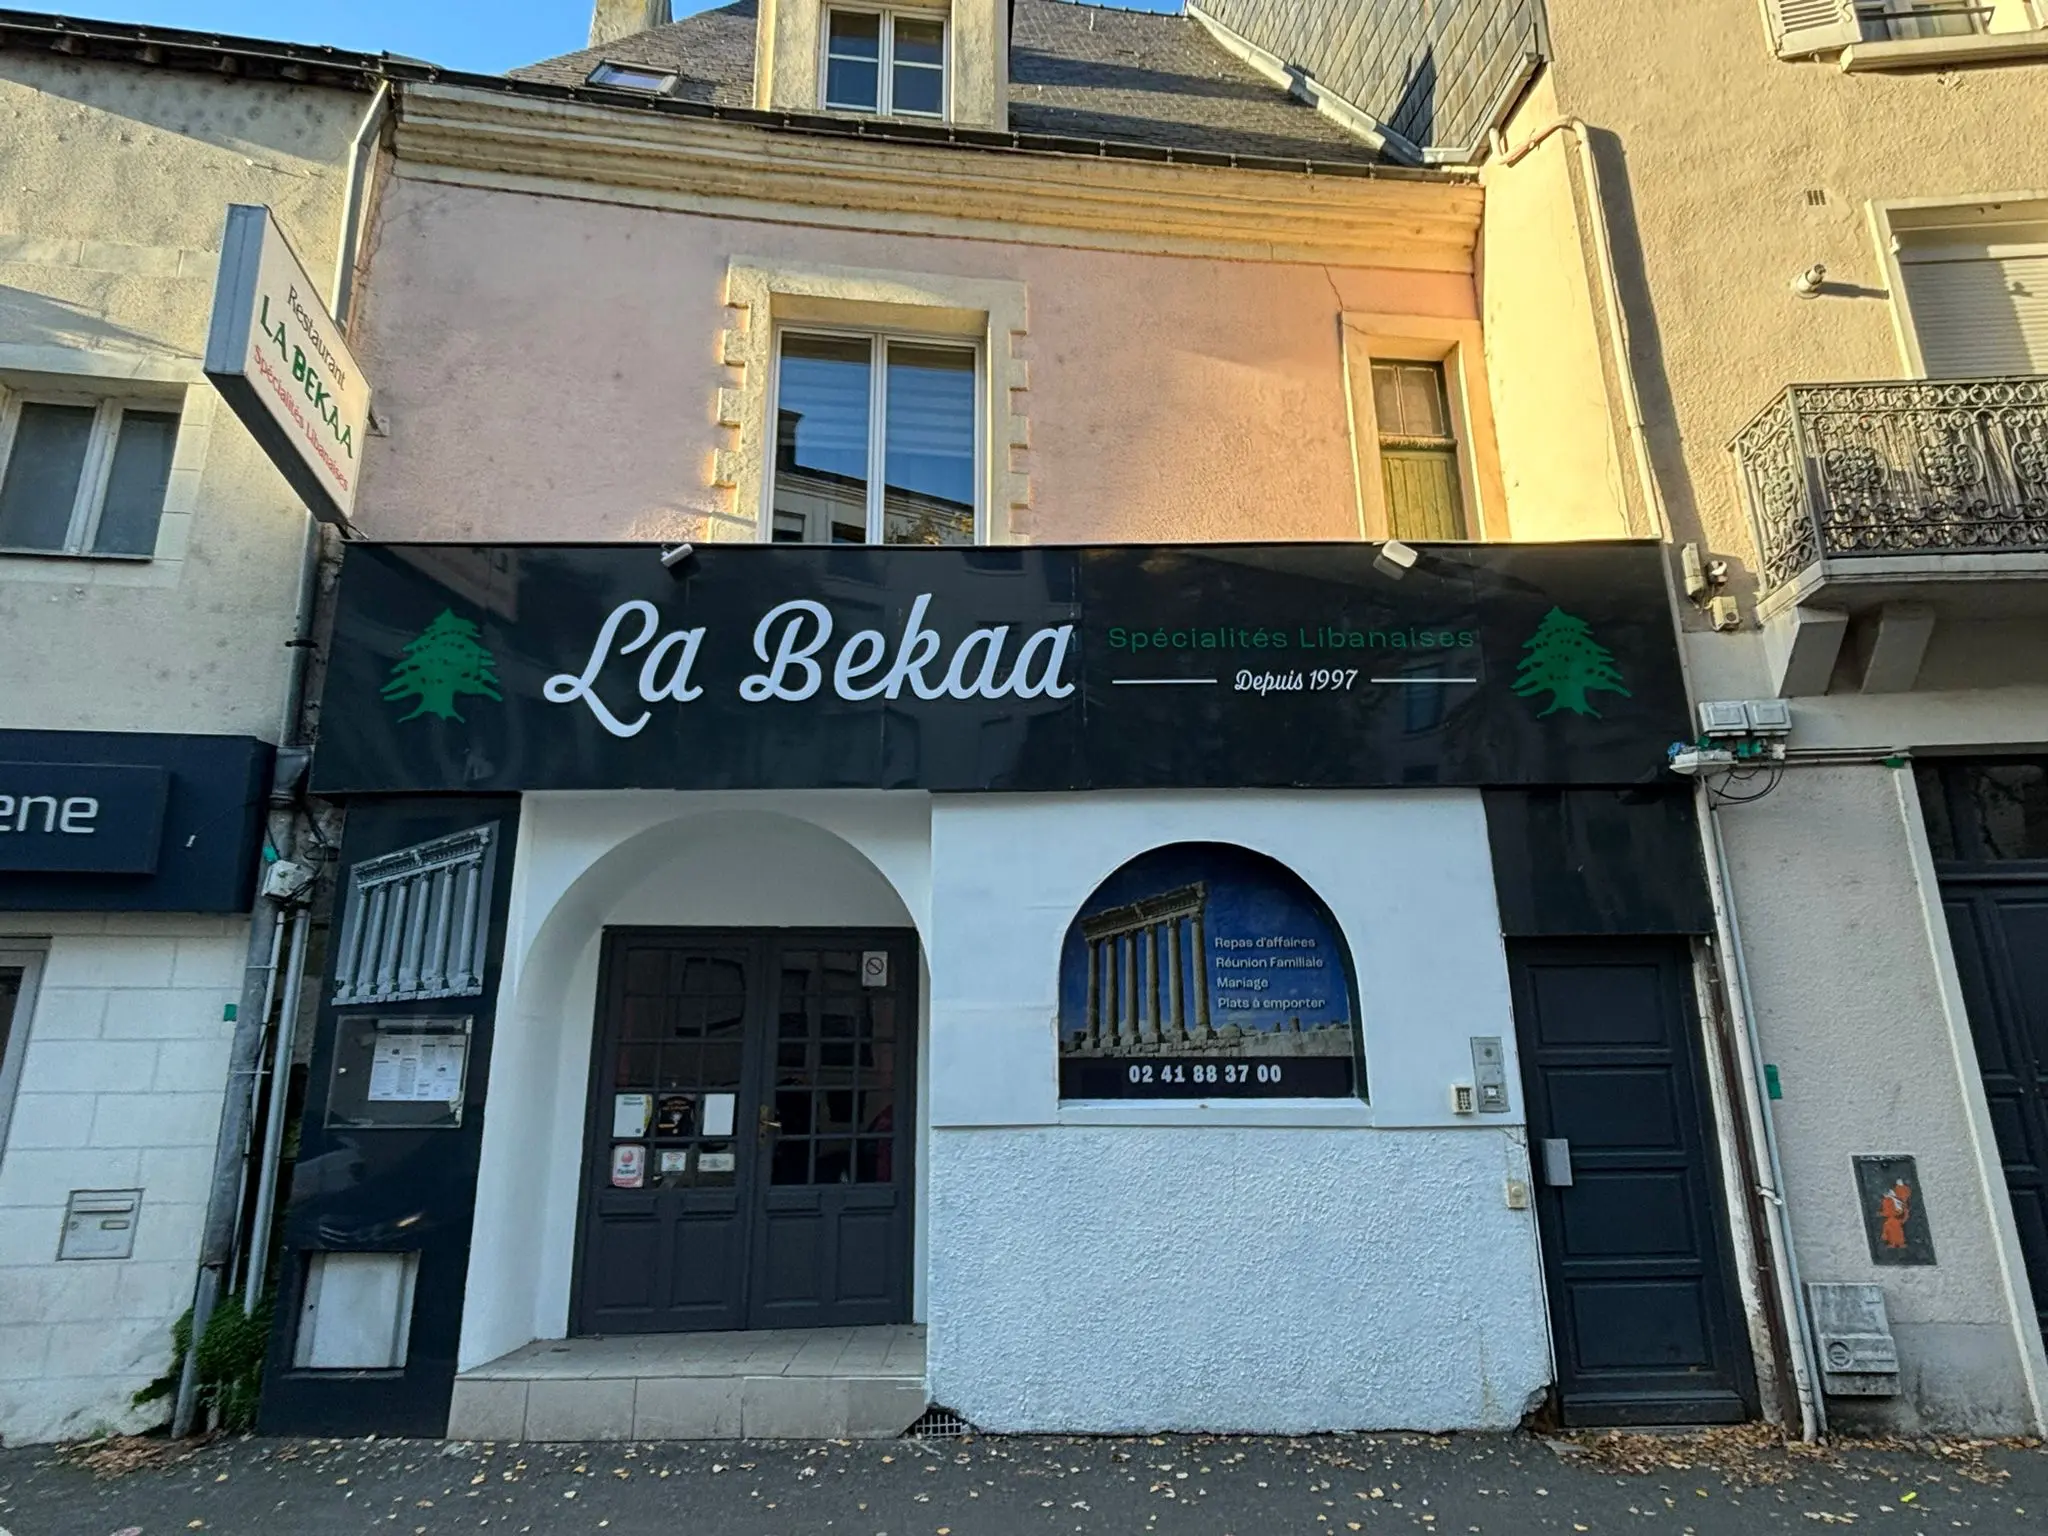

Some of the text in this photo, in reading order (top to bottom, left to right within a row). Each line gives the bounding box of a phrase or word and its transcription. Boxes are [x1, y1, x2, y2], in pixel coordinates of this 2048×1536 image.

[287, 283, 346, 391] Restaurant
[260, 295, 353, 459] LA BEKAA
[254, 344, 349, 492] Spécialités Libanaises
[1108, 627, 1475, 653] Spécialités Libanaises
[543, 592, 1076, 738] La Bekaa
[1234, 668, 1359, 697] Depuis 1997
[1215, 935, 1316, 950] Repas d'affaires
[1216, 955, 1323, 969] Réunion Familiale
[1217, 976, 1269, 991] Mariage
[1218, 997, 1250, 1009] Plats
[1263, 998, 1326, 1011] emporter
[1128, 1064, 1282, 1084] 02 41 88 37 00
